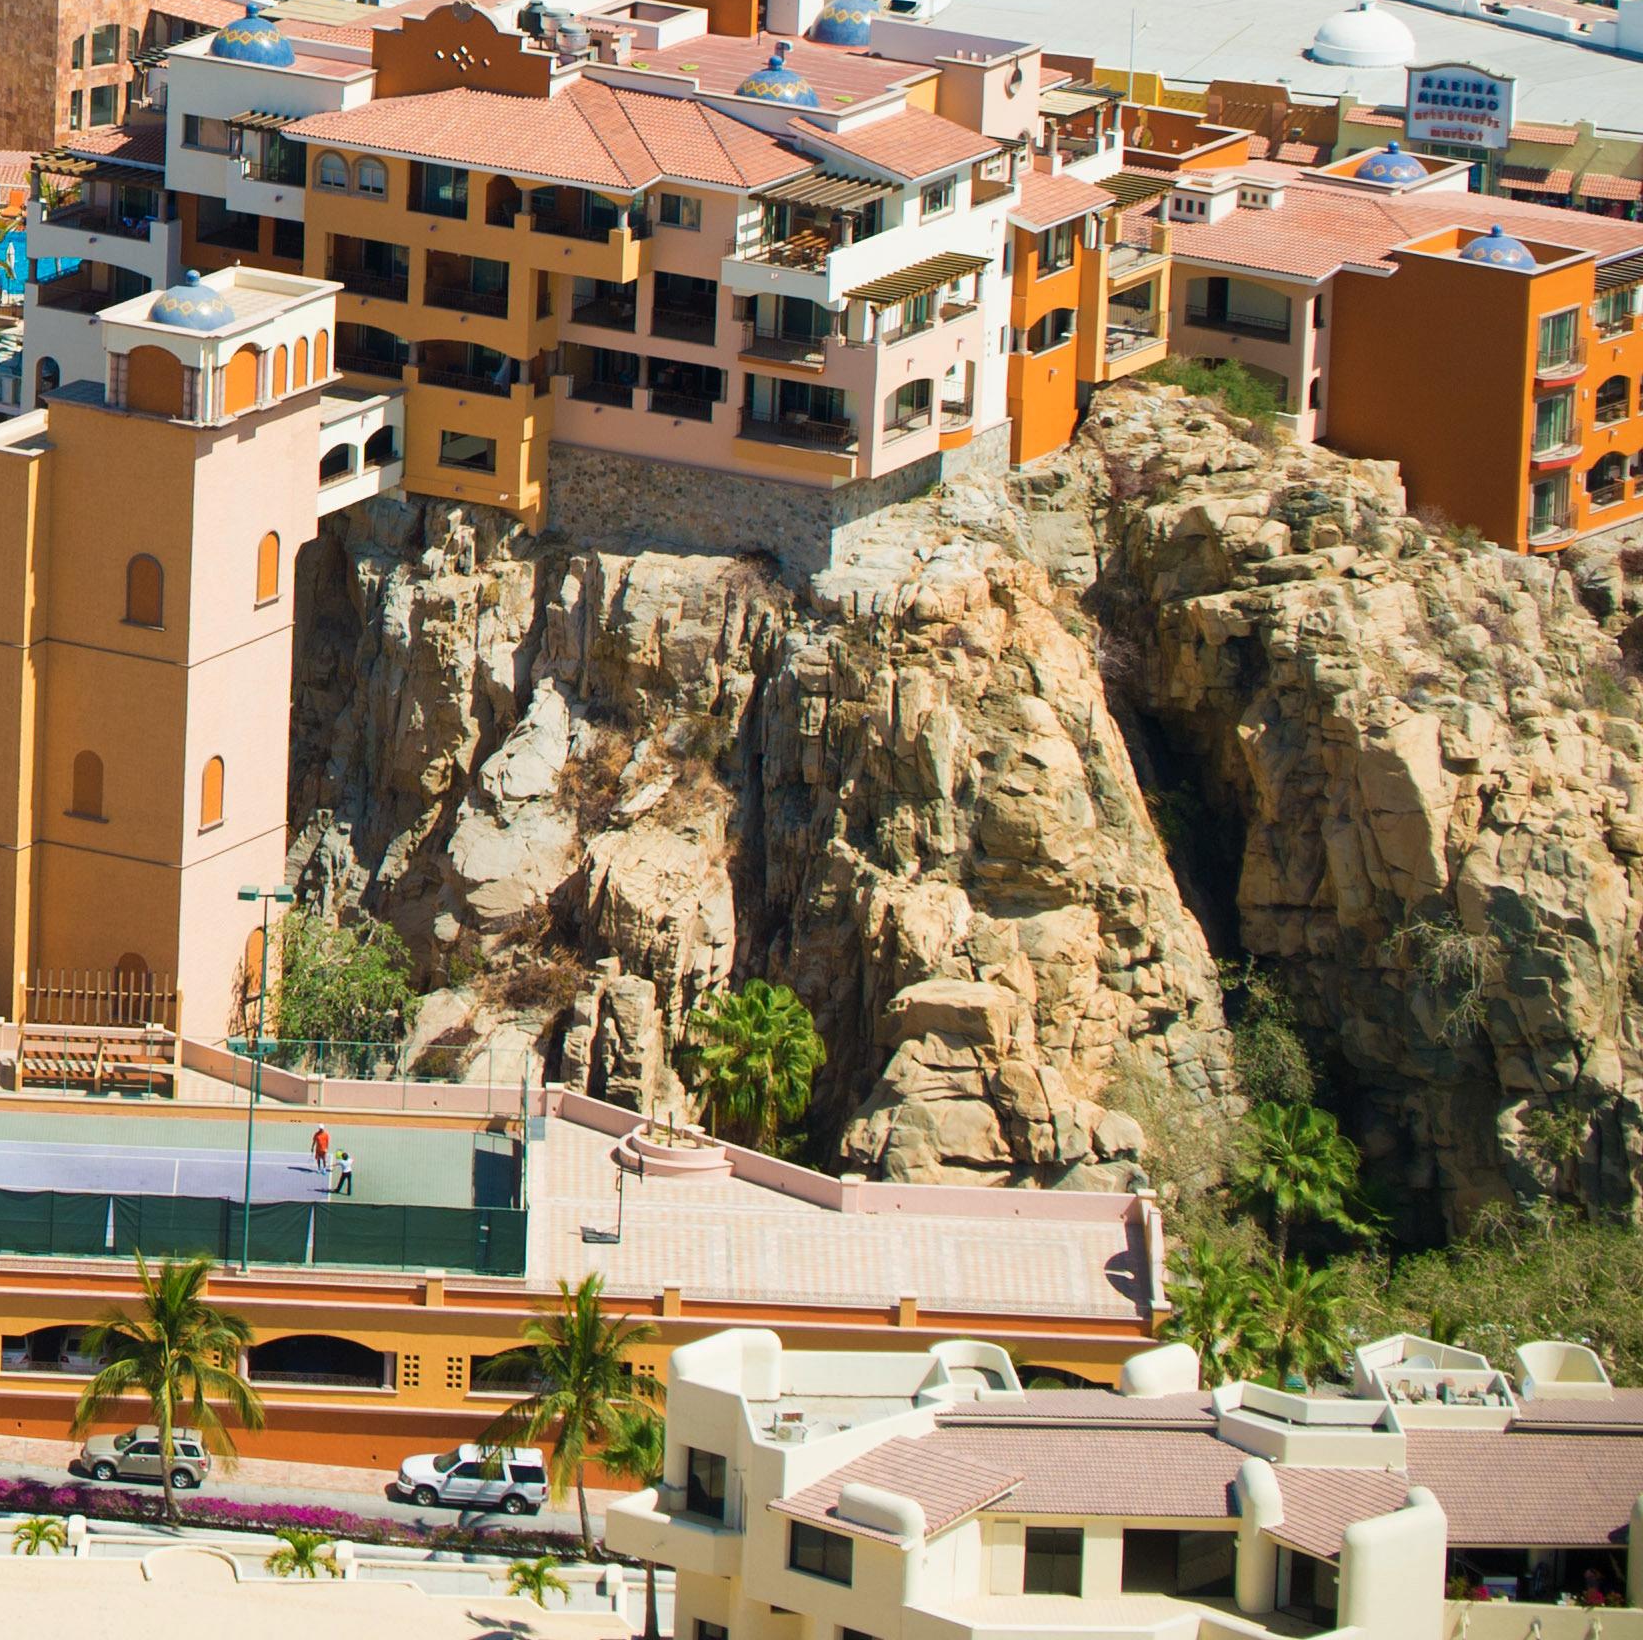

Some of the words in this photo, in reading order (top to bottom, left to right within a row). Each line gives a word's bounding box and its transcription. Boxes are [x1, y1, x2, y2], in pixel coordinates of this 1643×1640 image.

[1421, 77, 1498, 96] MARINA
[1418, 91, 1499, 112] MERCADO
[1430, 127, 1484, 142] market
